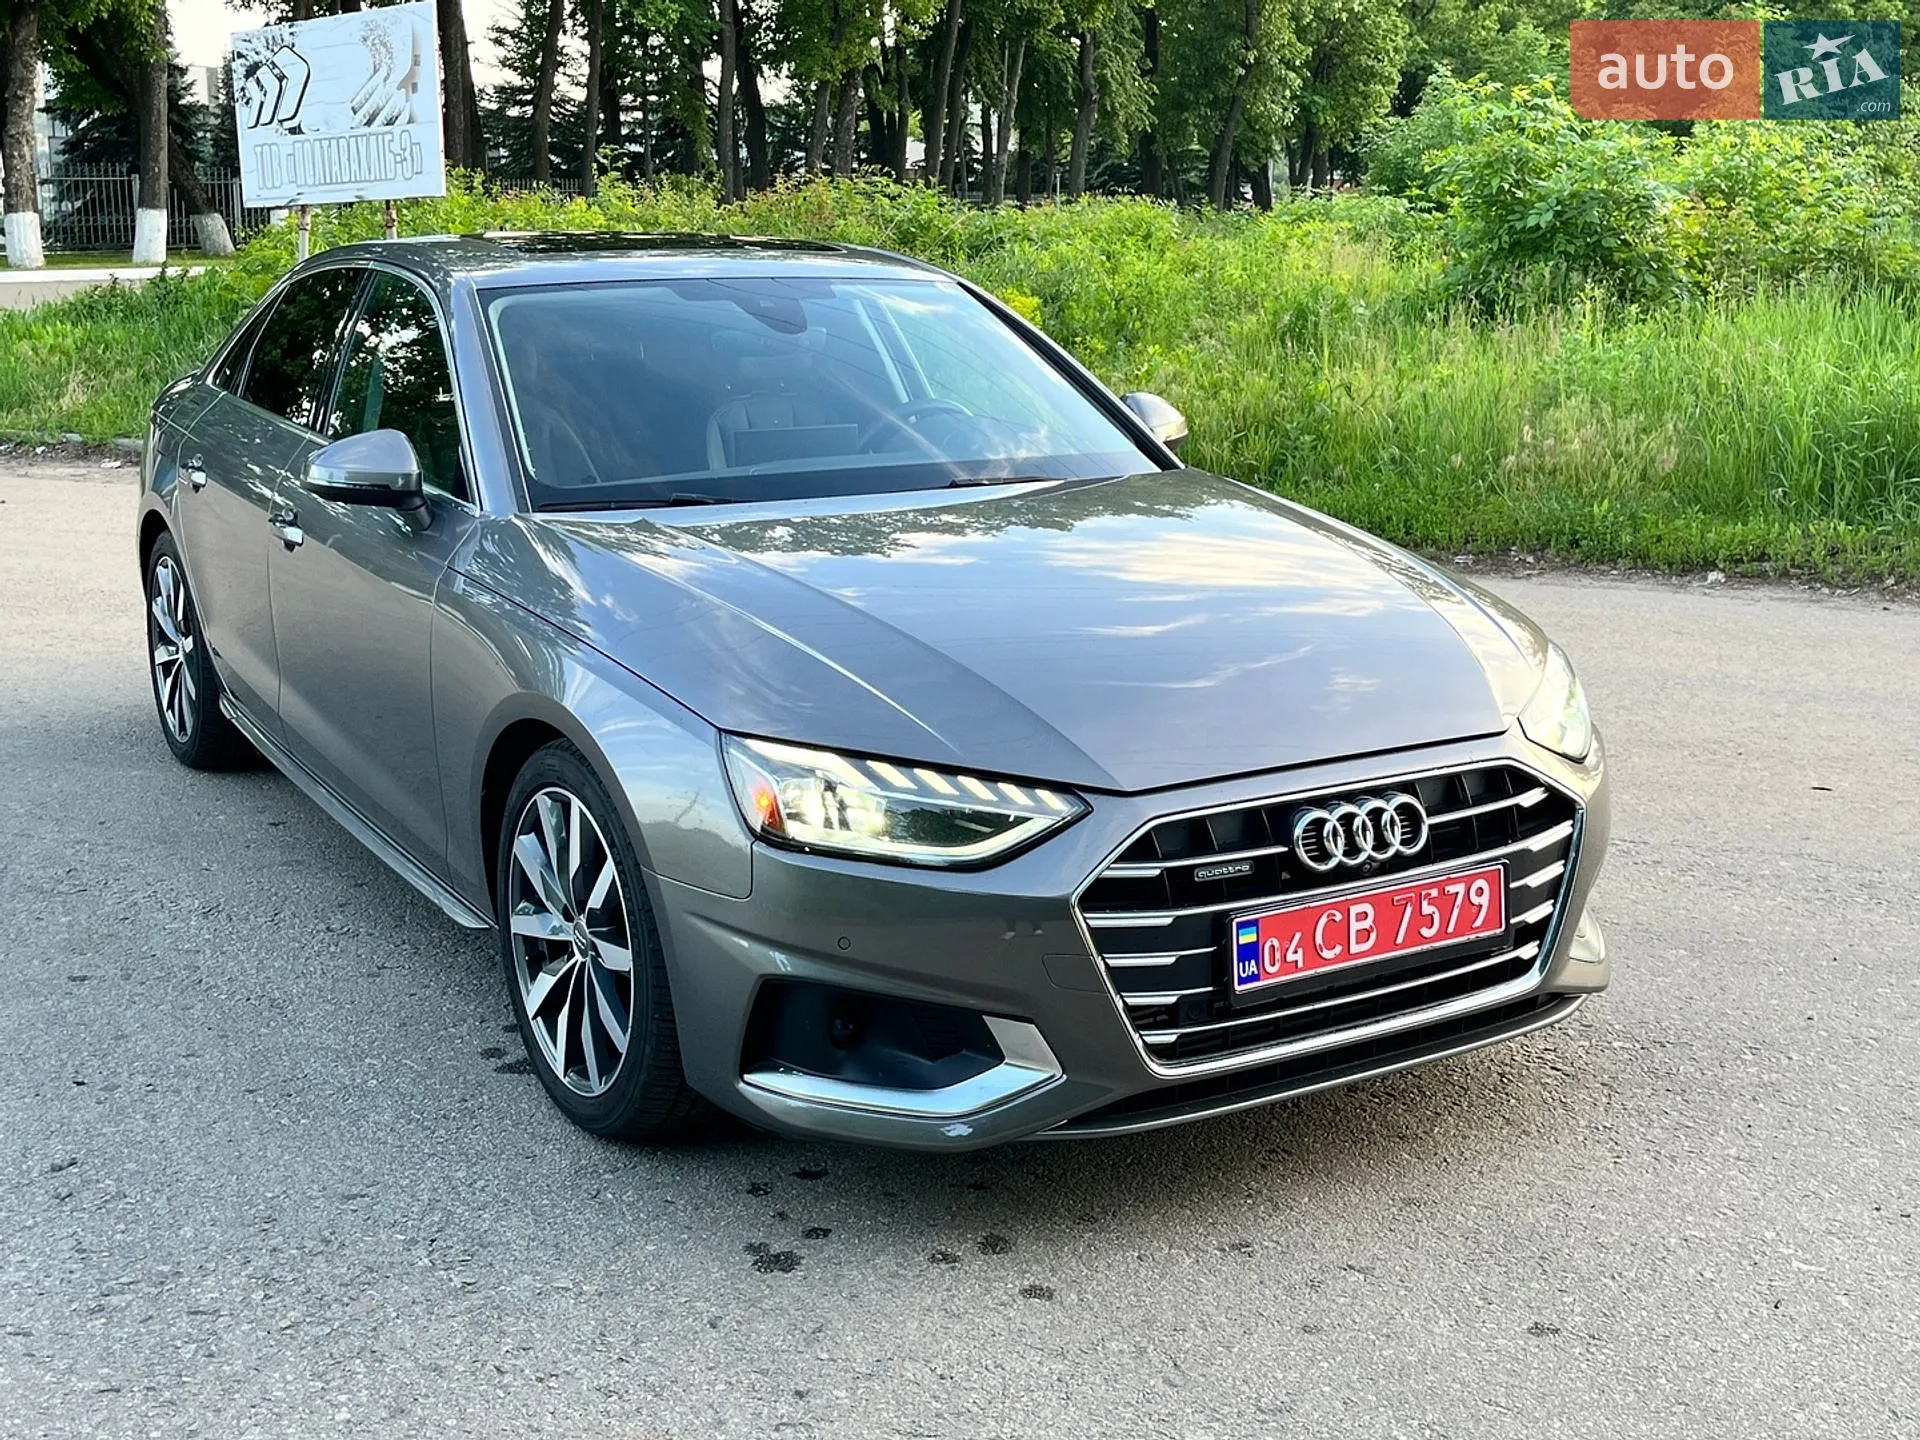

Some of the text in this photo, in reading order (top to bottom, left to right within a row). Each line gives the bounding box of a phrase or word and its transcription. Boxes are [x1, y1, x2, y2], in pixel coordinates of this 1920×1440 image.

[254, 142, 283, 190] ТОВ
[1197, 865, 1250, 878] quattro
[1393, 878, 1490, 946] 7579
[1239, 959, 1258, 978] UA
